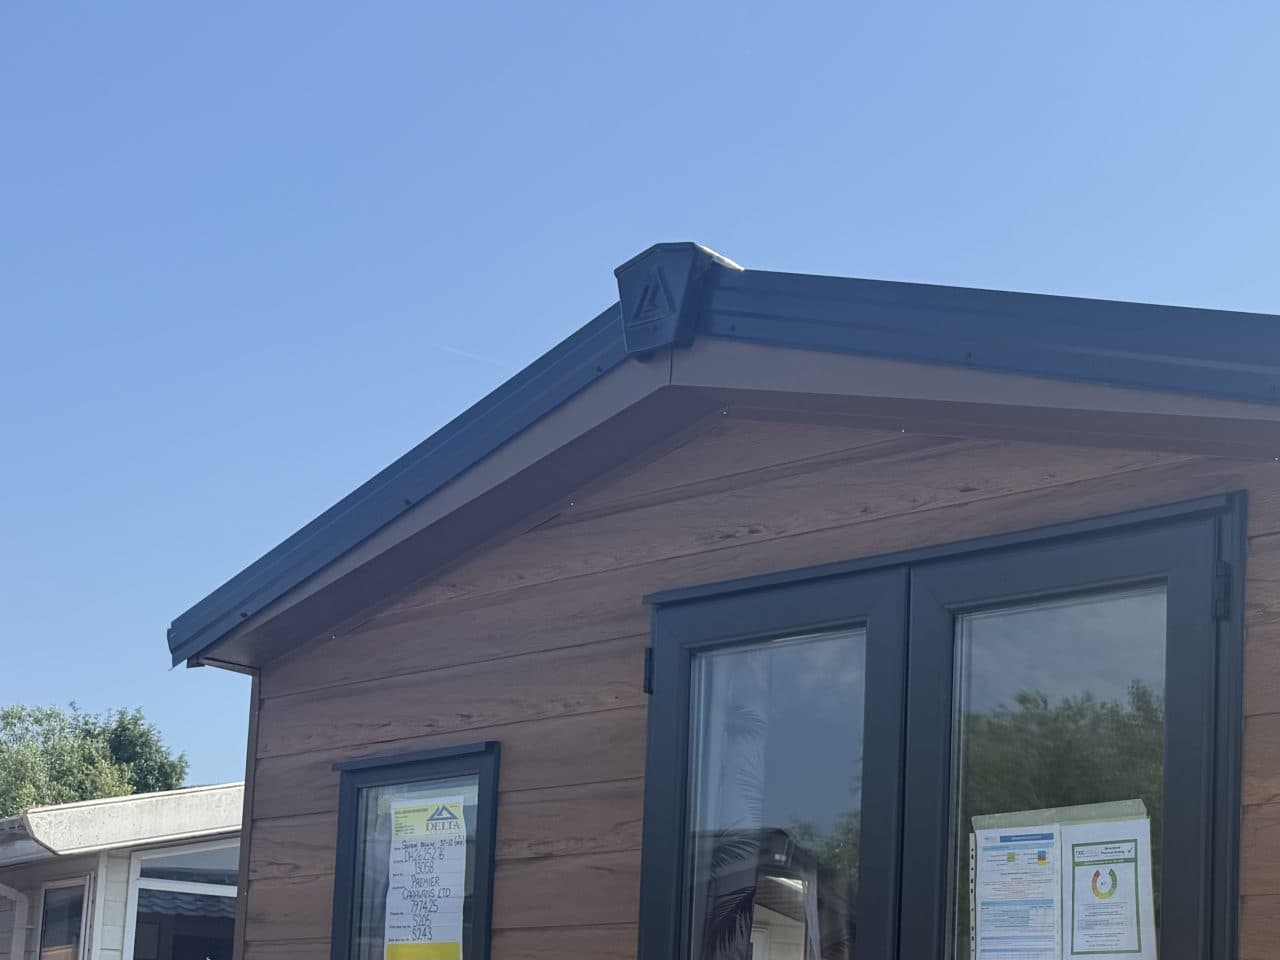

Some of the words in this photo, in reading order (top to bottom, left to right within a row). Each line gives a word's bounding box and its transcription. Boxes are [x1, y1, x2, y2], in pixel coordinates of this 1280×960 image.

[425, 821, 460, 832] DELTA
[411, 874, 440, 889] PREMIER
[437, 887, 451, 899] LTD
